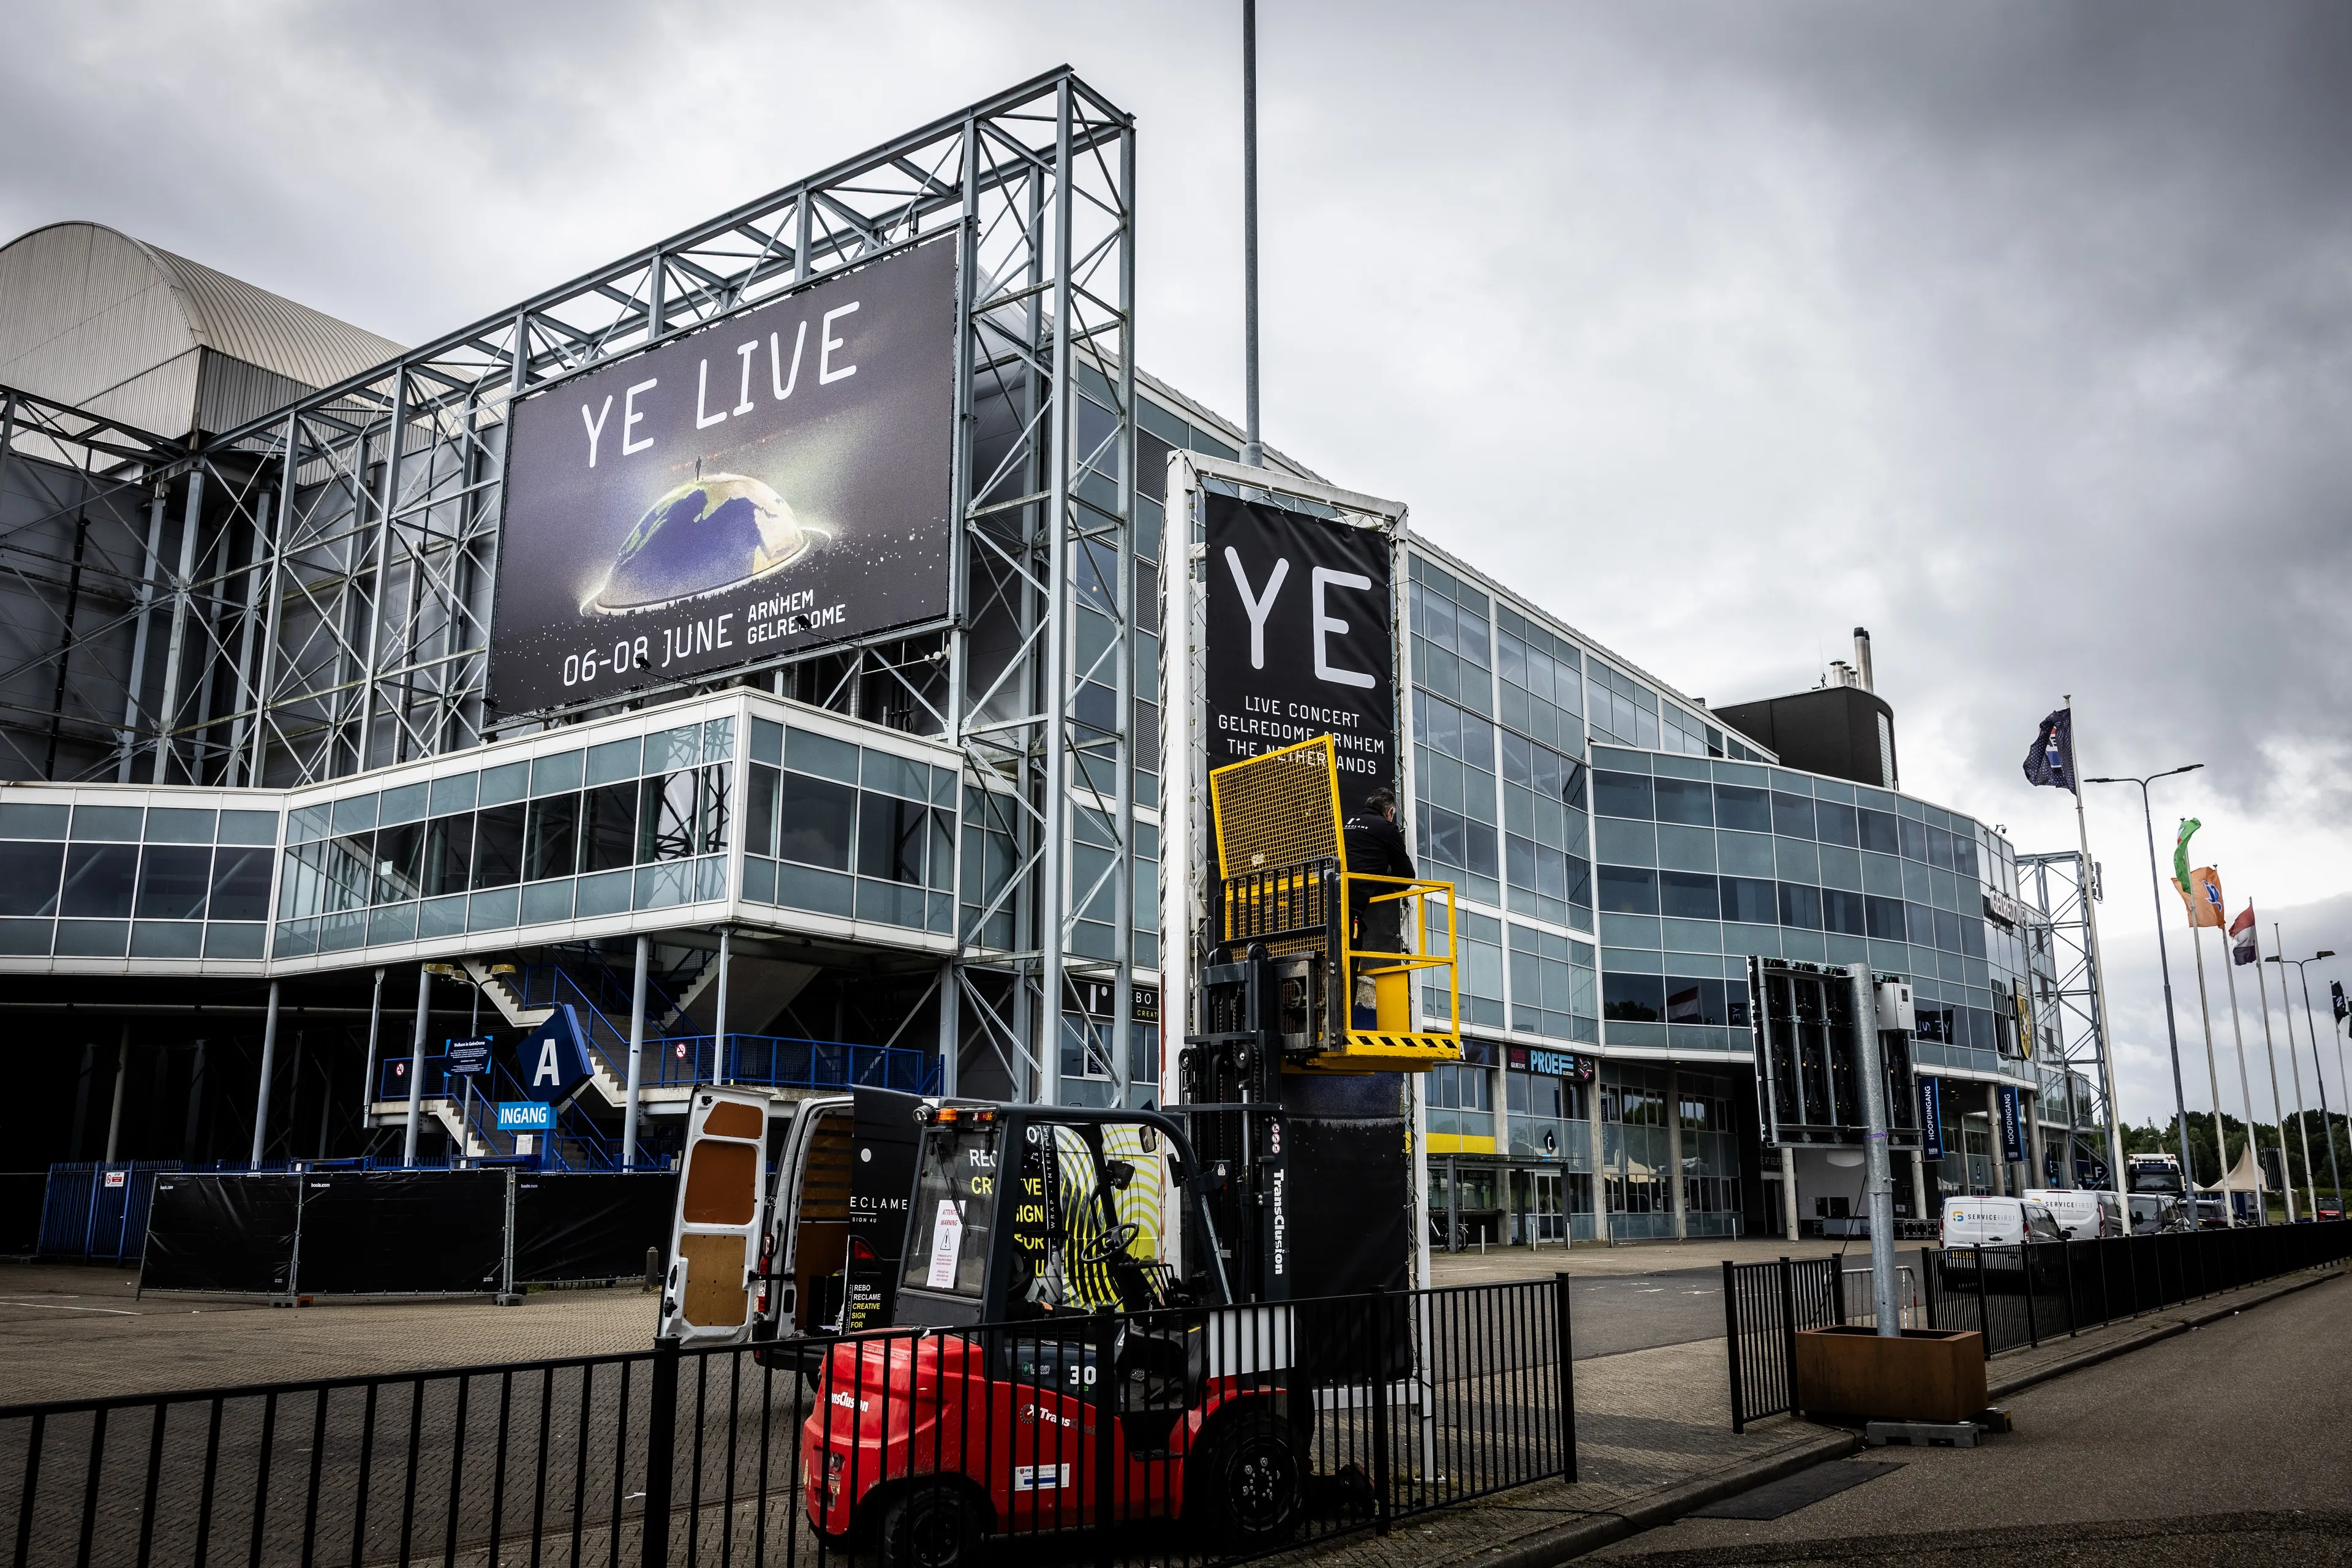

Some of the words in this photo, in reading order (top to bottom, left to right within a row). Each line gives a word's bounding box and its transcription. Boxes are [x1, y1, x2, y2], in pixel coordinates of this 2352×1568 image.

[581, 378, 658, 468] YE
[696, 301, 860, 429] LIVE
[747, 589, 813, 623] ARNHEM
[1225, 546, 1376, 689] YE
[747, 603, 846, 645] GELREOME
[563, 636, 649, 687] 06-08
[661, 612, 734, 668] JUNE
[1218, 714, 1314, 742] GELREDOME
[1245, 695, 1281, 715] LIVE
[1289, 703, 1360, 728] CONCERT
[1227, 738, 1257, 757] THE
[533, 1039, 560, 1087] A
[1530, 1050, 1574, 1075] PROEF
[500, 1107, 547, 1124] INGANG
[1924, 1085, 1935, 1140] HOOFDINGANG
[2004, 1093, 2015, 1144] HOOFDINGANG
[1547, 1136, 1552, 1150] C
[2095, 1167, 2102, 1178] F
[850, 1196, 908, 1210] ECLAME
[1273, 1169, 1285, 1275] TransClusion
[1069, 1365, 1096, 1384] 30
